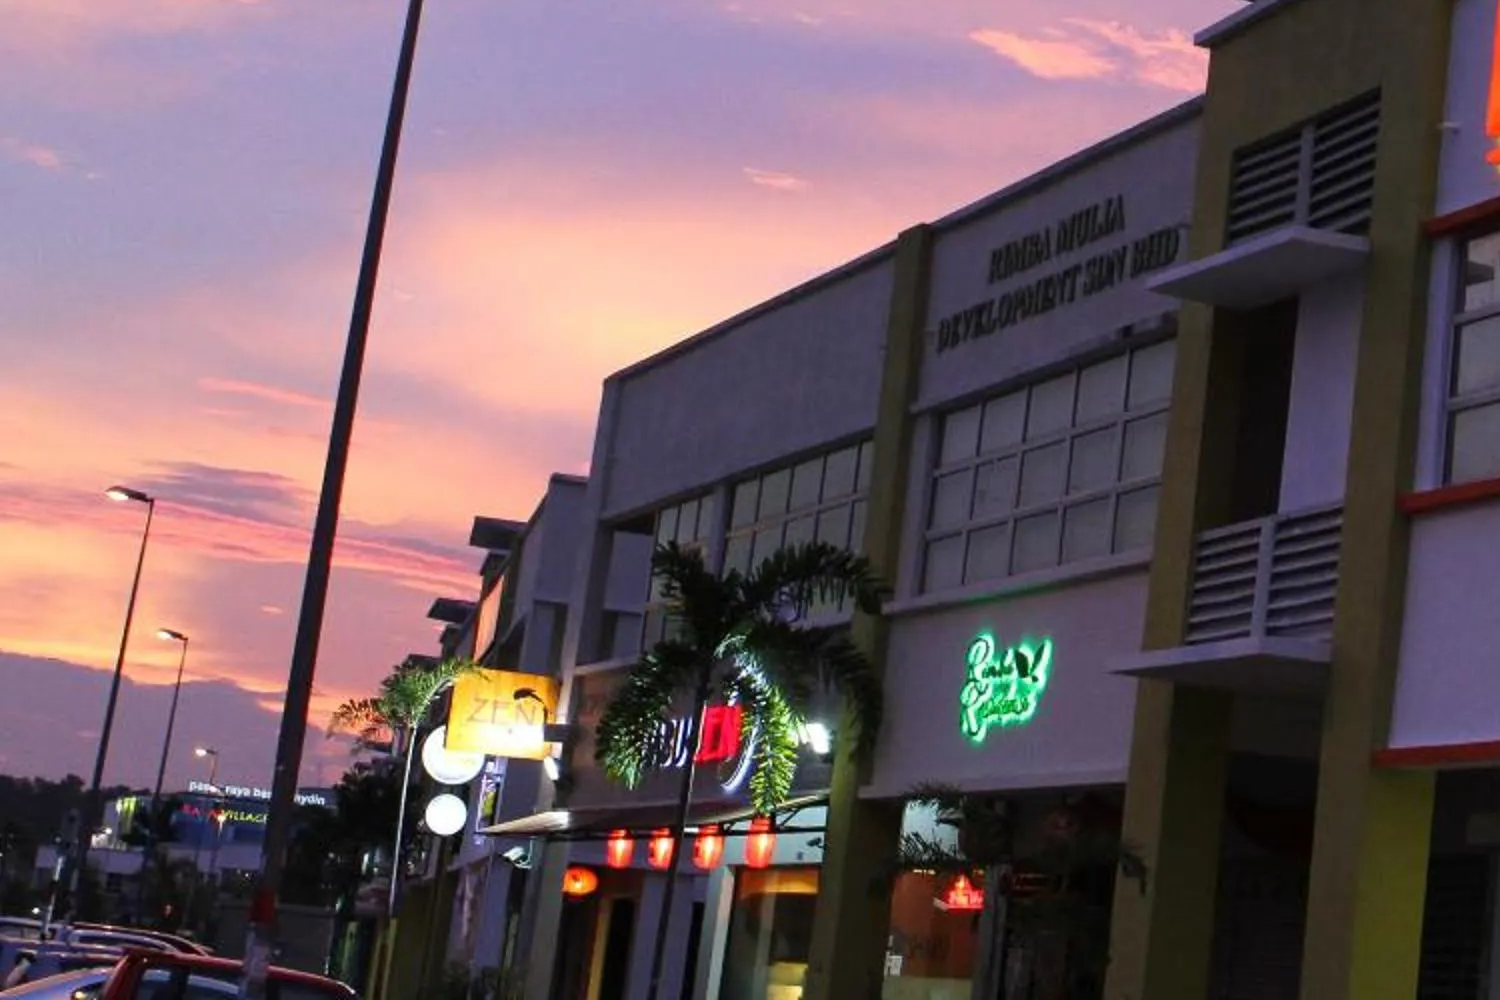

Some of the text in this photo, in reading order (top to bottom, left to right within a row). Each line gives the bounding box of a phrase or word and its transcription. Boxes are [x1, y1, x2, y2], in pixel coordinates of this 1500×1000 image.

[1056, 194, 1125, 256] MULIA
[937, 263, 1083, 354] DEVELOPMENT
[293, 793, 326, 806] ydin
